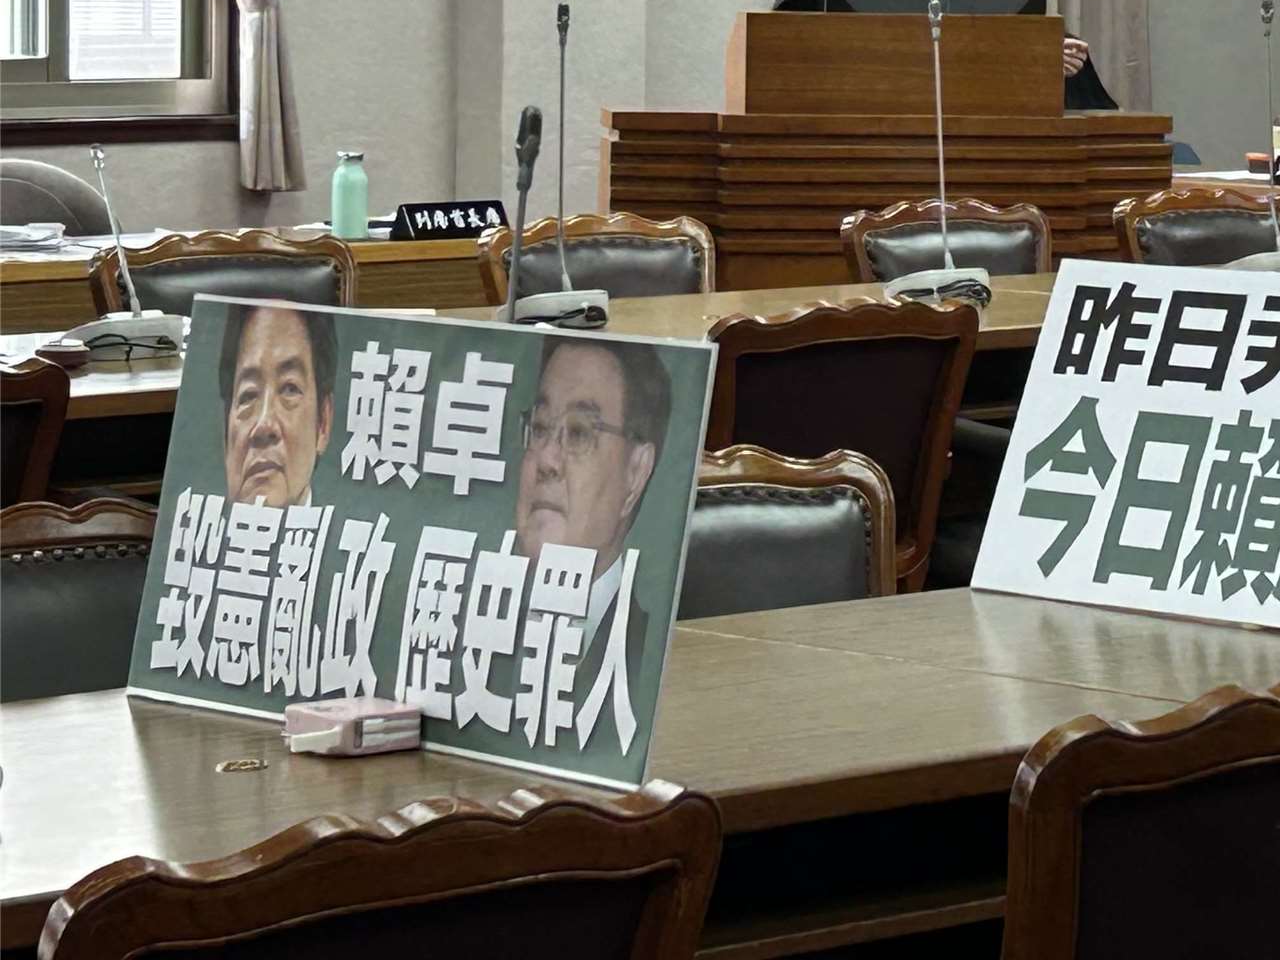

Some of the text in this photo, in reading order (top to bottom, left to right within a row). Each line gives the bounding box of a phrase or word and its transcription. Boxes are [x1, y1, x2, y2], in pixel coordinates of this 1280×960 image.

[341, 341, 514, 495] 賴卓
[150, 487, 639, 756] 毀憲亂政 歷史罪人
